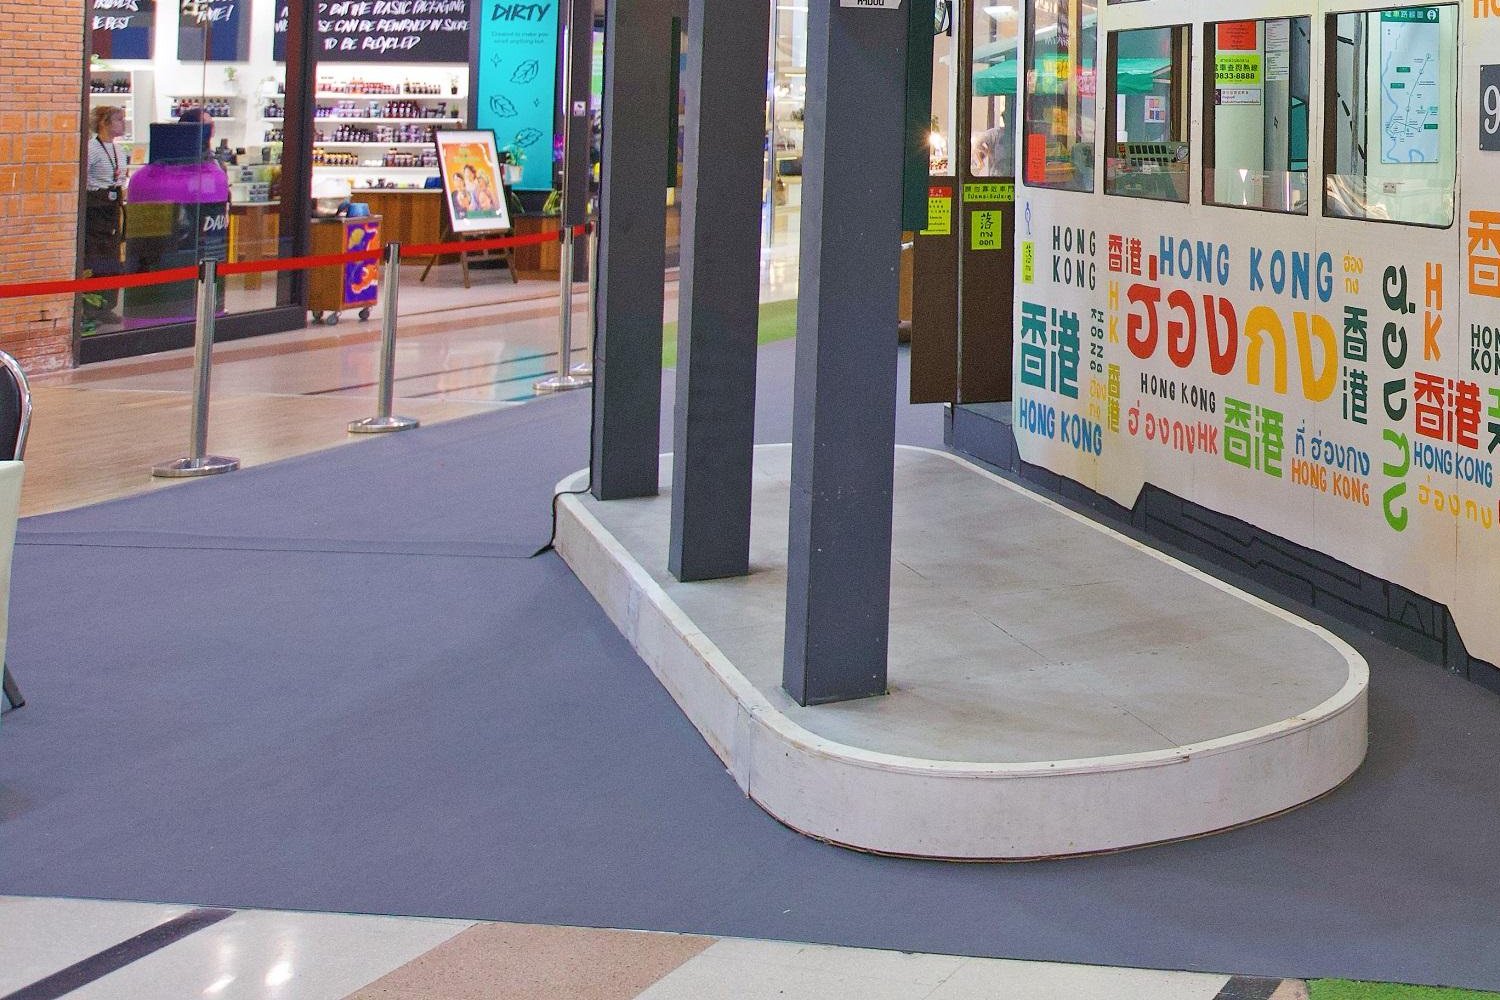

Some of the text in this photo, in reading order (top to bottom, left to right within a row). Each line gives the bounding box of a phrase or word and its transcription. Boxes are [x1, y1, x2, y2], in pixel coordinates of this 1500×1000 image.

[491, 3, 551, 22] DIRTY
[341, 37, 358, 50] BE
[362, 36, 421, 54] RECYCLED
[1483, 84, 1500, 135] 9
[1053, 226, 1096, 257] HONG
[1108, 234, 1142, 276] 香港
[1159, 235, 1333, 303] HONG KONG
[1053, 255, 1096, 291] KONG
[1424, 262, 1443, 362] HK
[1020, 301, 1080, 399] 香港
[1090, 308, 1098, 373] KONG
[1343, 305, 1368, 425] 香港
[1107, 363, 1121, 434] 香港
[1140, 372, 1216, 414] HONG KONG
[1413, 371, 1481, 450] 香港
[1019, 397, 1102, 457] HONG KONG
[1224, 396, 1284, 478] 香港
[1291, 458, 1370, 506] HONG KONG
[1414, 441, 1493, 489] HONG KONG
